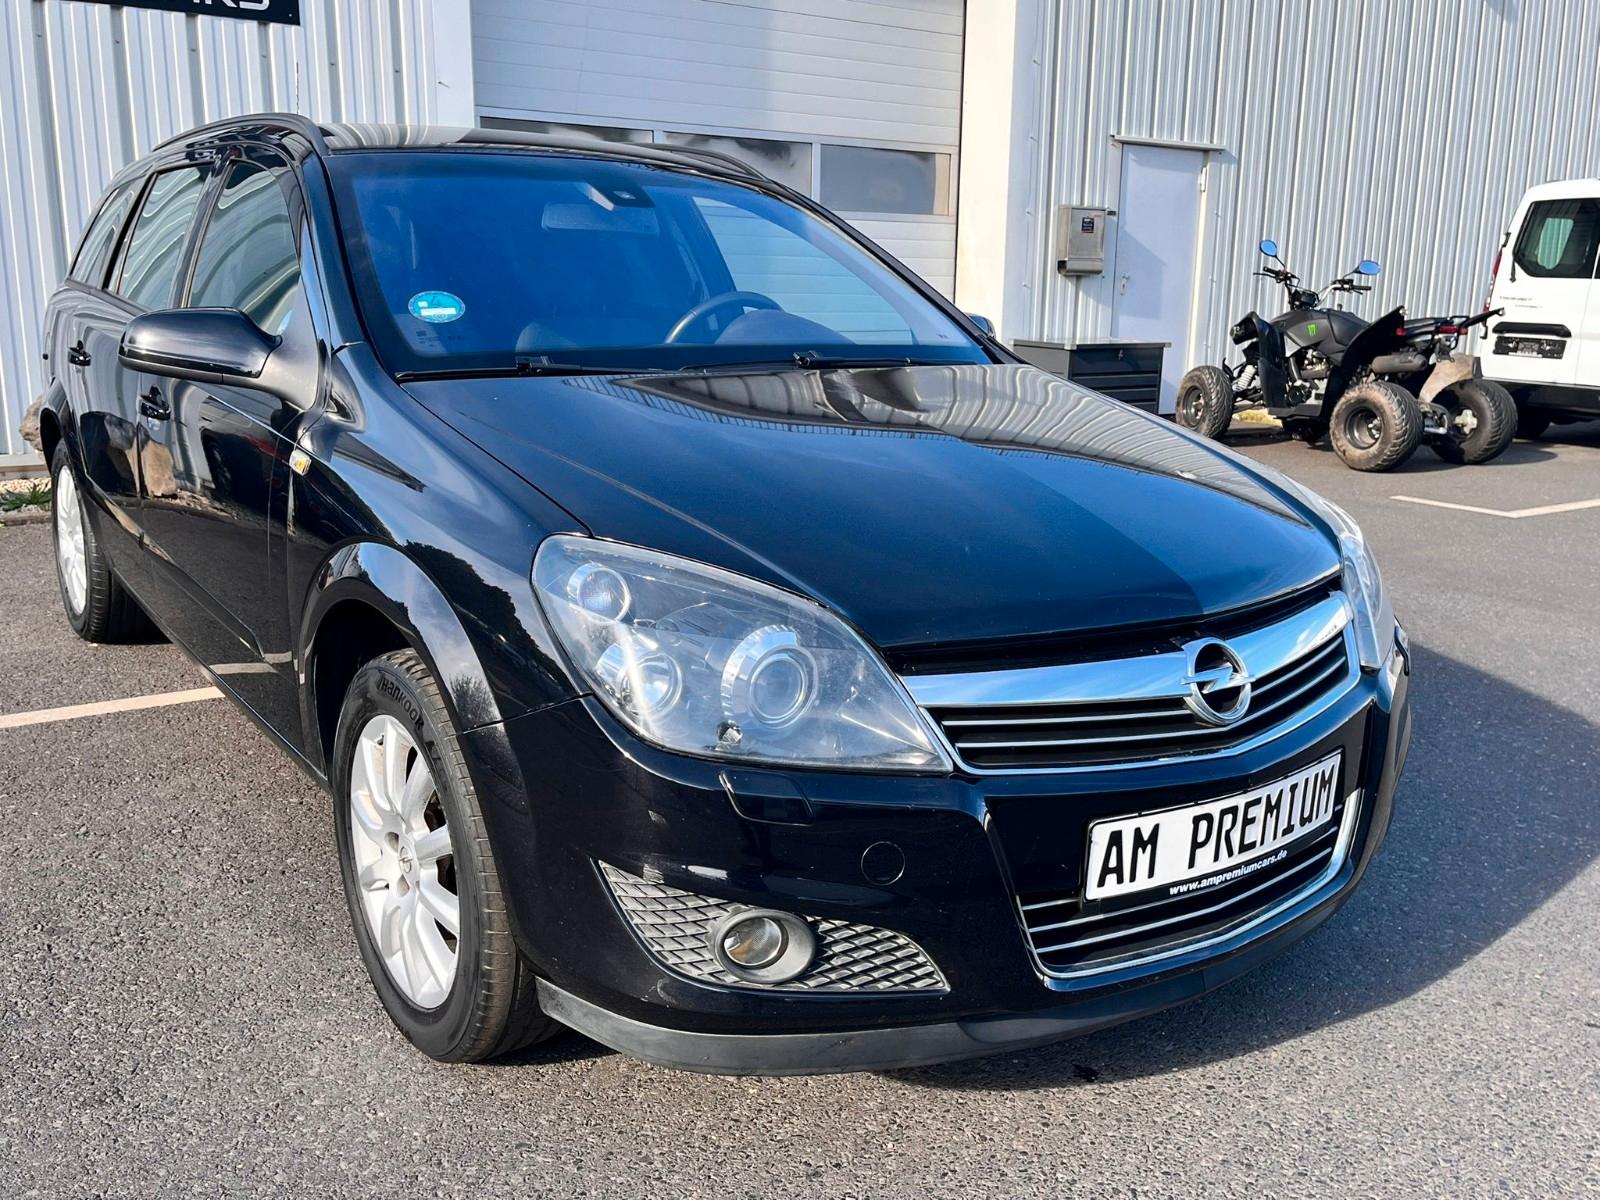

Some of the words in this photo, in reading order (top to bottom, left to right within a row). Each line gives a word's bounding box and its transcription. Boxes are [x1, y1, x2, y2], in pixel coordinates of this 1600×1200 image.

[1097, 823, 1160, 888] AM
[1188, 764, 1335, 870] PREMIUM
[1169, 849, 1287, 895] www.ampremiumcars.de
